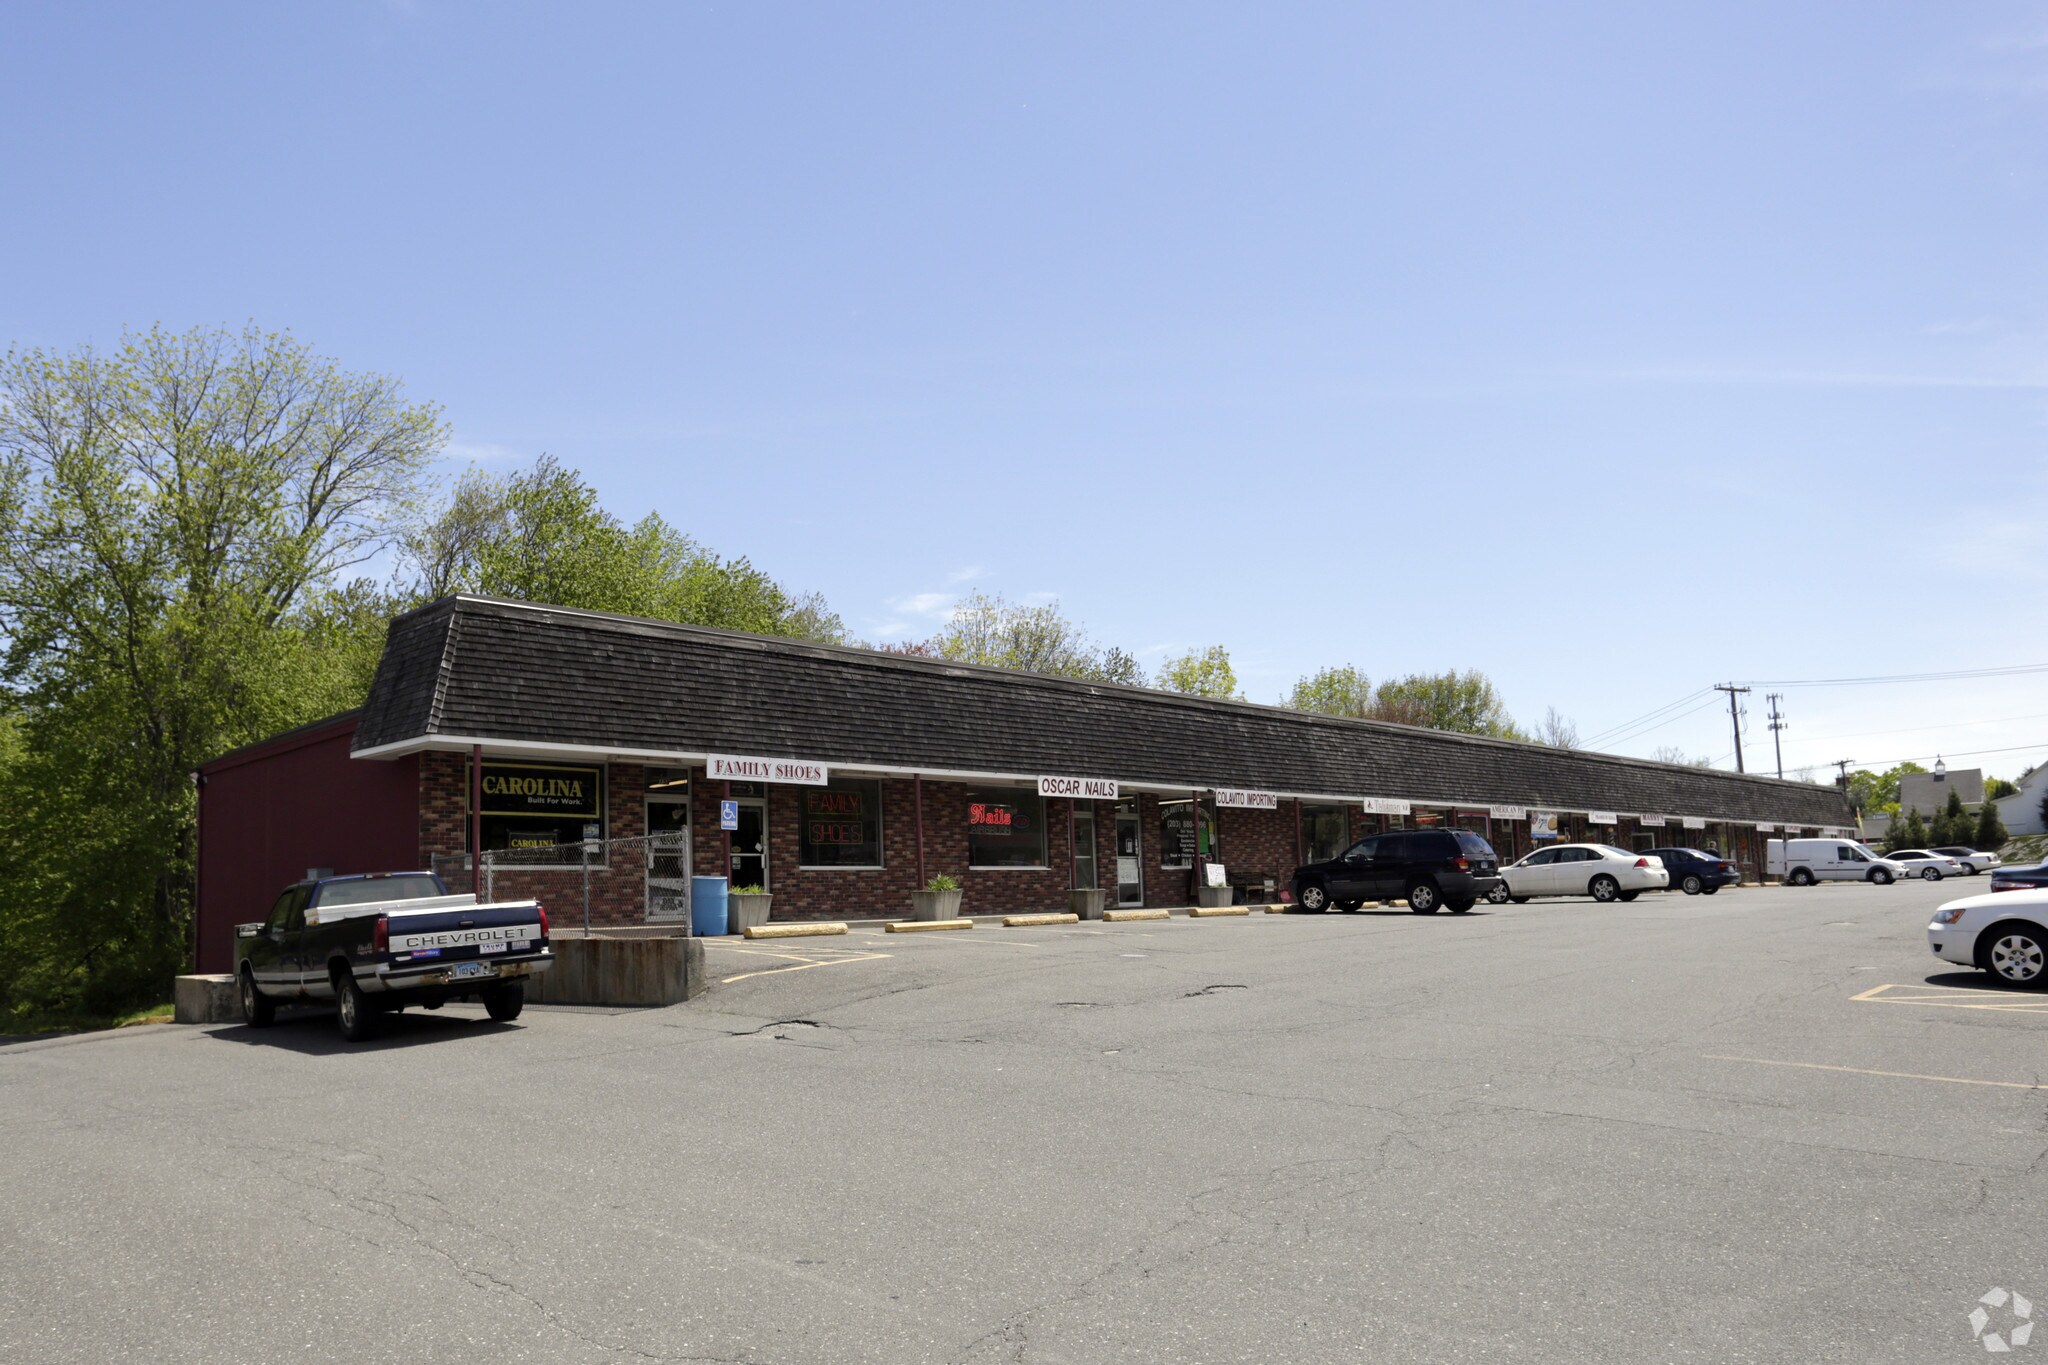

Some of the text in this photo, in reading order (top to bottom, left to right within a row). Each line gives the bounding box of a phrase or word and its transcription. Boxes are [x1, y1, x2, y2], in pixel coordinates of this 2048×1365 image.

[714, 760, 821, 781] FAMILY SHOES
[482, 776, 583, 797] CAROLINA
[1042, 778, 1115, 797] OSCAR NAILS
[528, 796, 583, 806] Built For Work.
[809, 793, 858, 812] FAMILY
[1217, 791, 1276, 807] COLAVITO IMPORTING
[970, 803, 1012, 825] Nails
[811, 823, 860, 842] SHOES
[511, 839, 555, 849] CAROLINA
[406, 928, 527, 947] CHEVROLET
